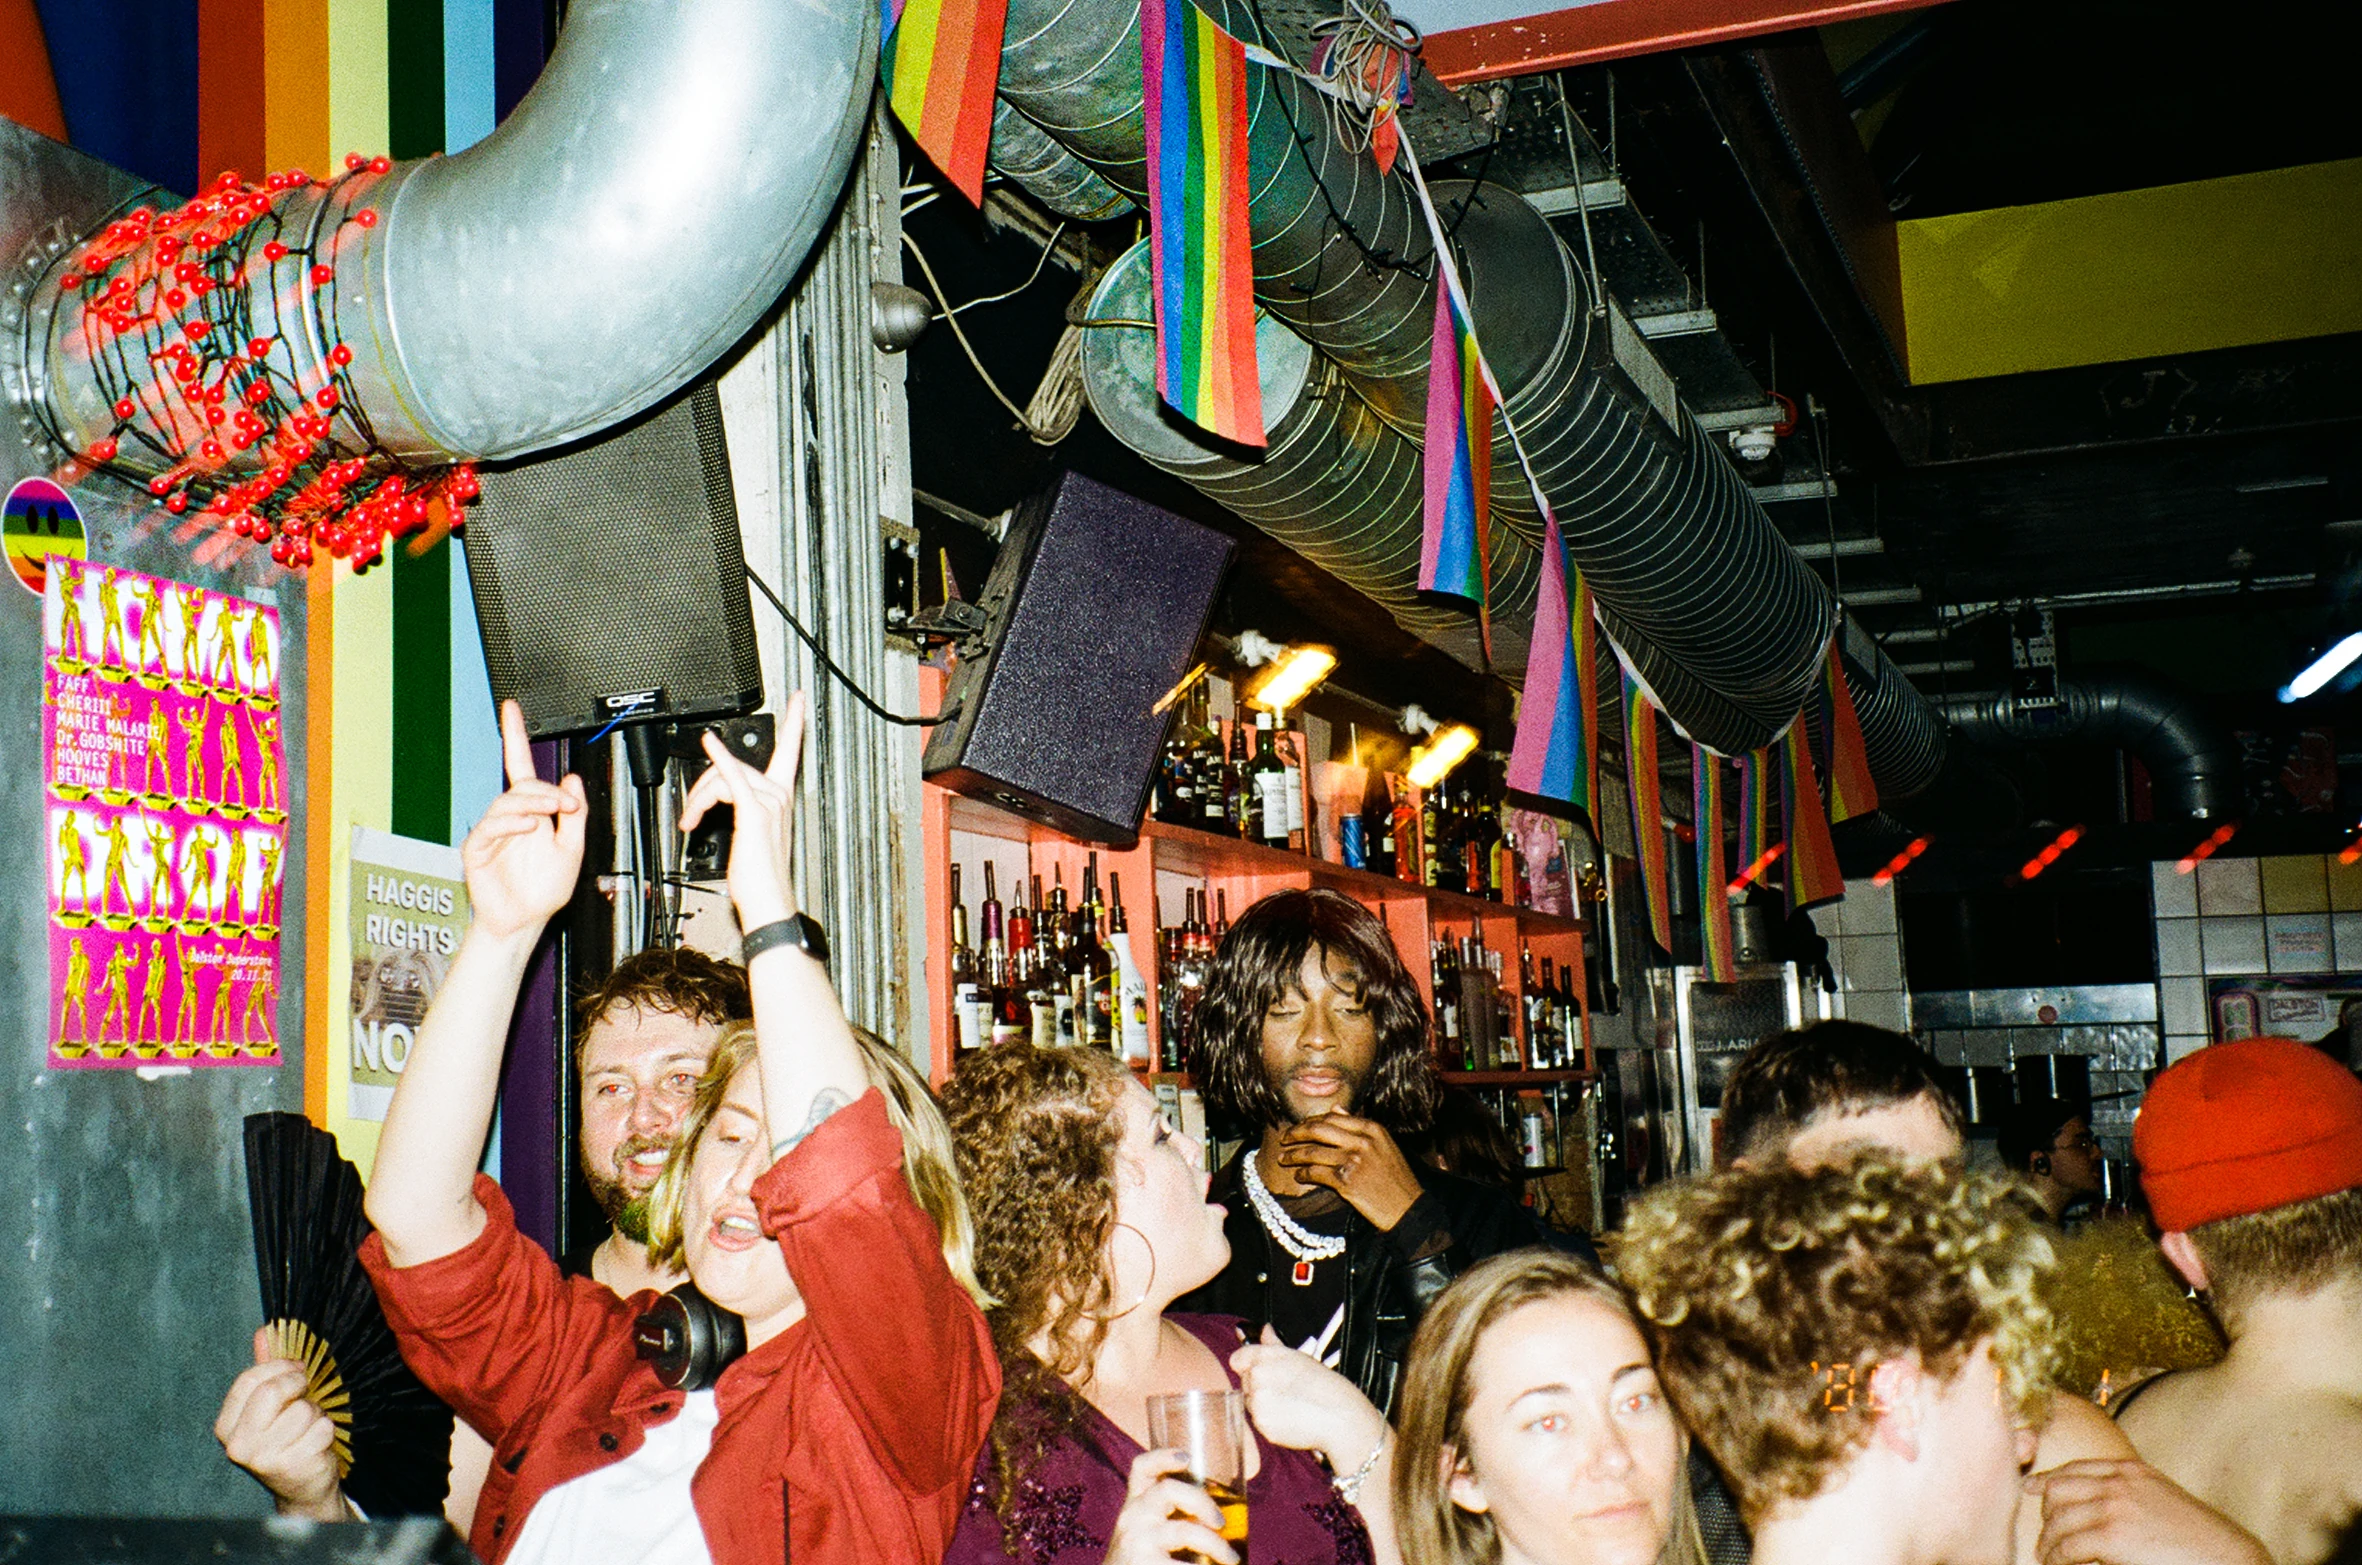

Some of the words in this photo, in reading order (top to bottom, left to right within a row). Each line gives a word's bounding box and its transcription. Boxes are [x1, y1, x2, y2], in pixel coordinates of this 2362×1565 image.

[57, 674, 89, 693] FAFF
[606, 692, 656, 708] QSC
[56, 711, 100, 731] MARIE
[106, 718, 159, 740] MALARIE
[57, 747, 109, 768] HOOVES
[57, 765, 107, 785] BETHAN
[366, 873, 455, 916] HAGGIS
[365, 914, 456, 956] RIGHTS
[353, 1018, 421, 1074] NO
